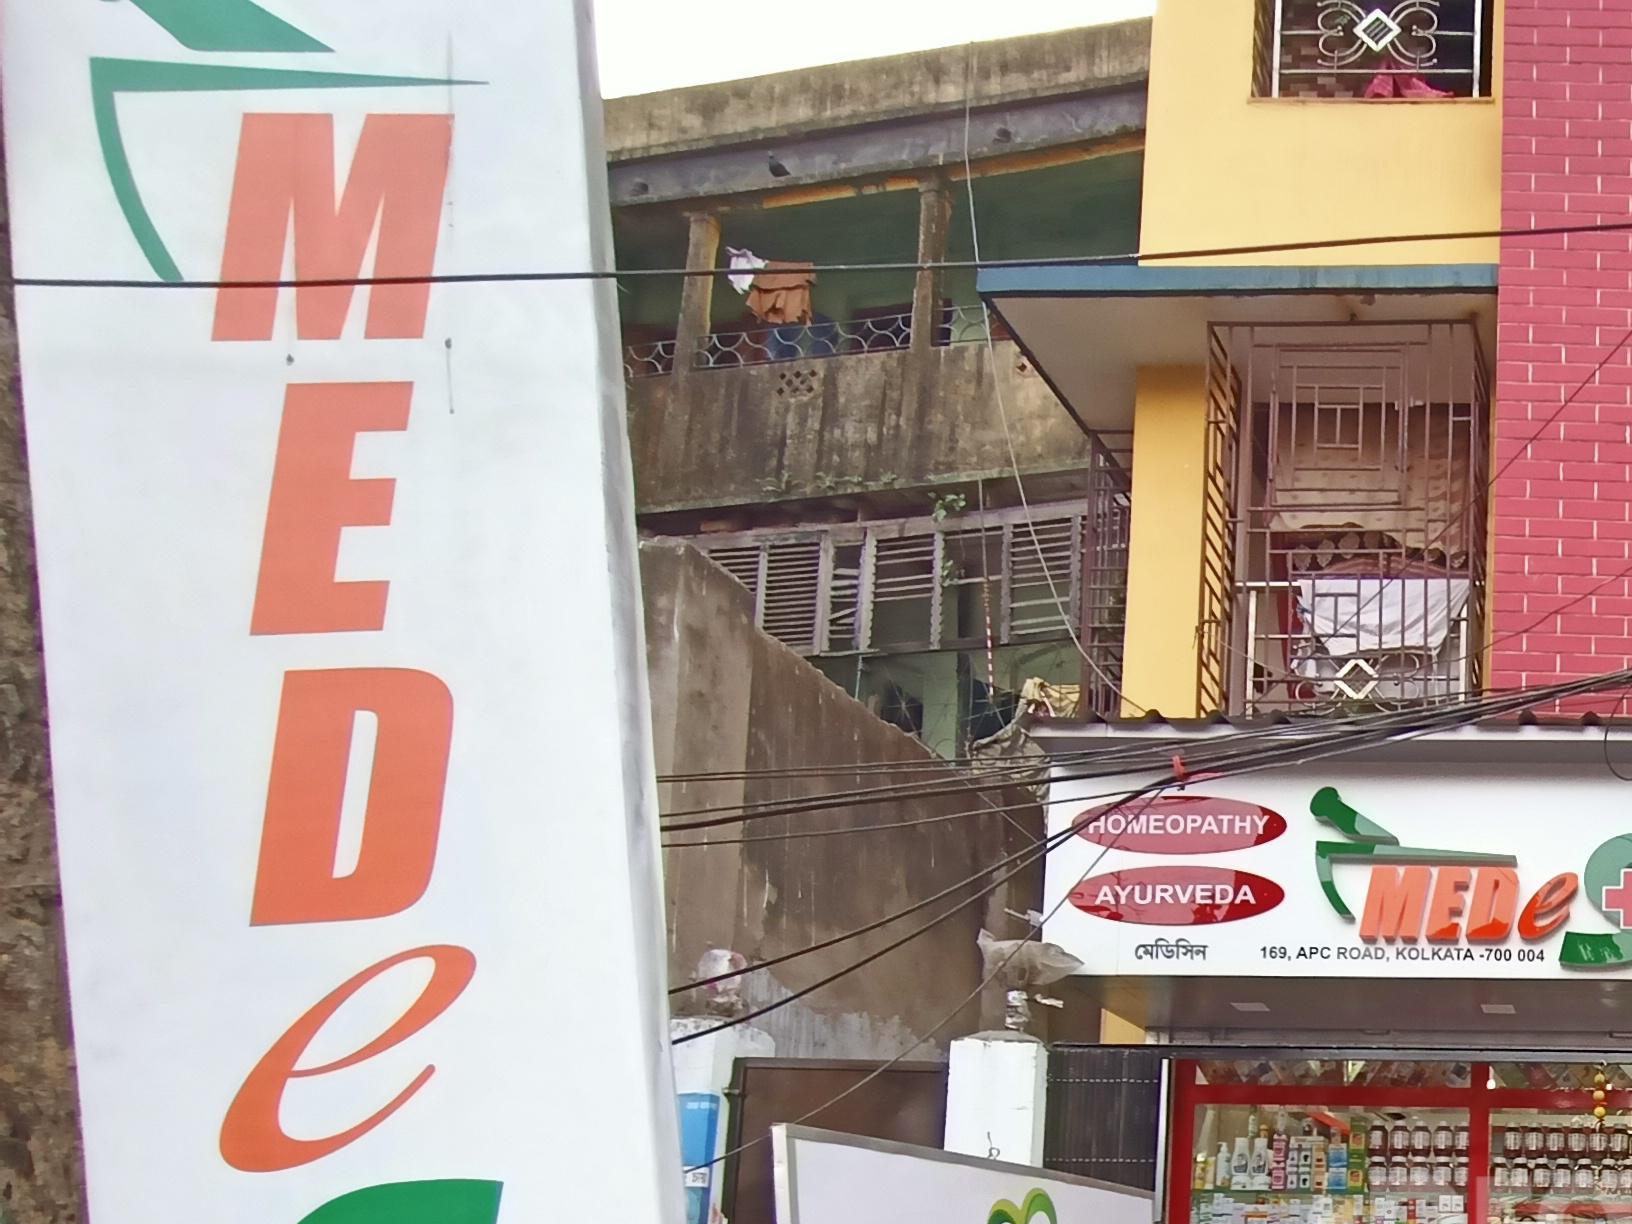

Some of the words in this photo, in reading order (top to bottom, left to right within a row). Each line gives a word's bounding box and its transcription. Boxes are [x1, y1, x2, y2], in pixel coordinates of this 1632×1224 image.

[1087, 814, 1270, 835] HOMEOPATHY
[1094, 884, 1257, 905] AYURVEDA
[1134, 938, 1208, 961] মেডিসিন
[1260, 946, 1292, 962] 169,
[1296, 946, 1331, 960] APC
[1336, 947, 1390, 962] ROAD,
[1395, 947, 1475, 961] KOLKATA
[1478, 948, 1513, 962] -700
[1517, 949, 1545, 963] 004
